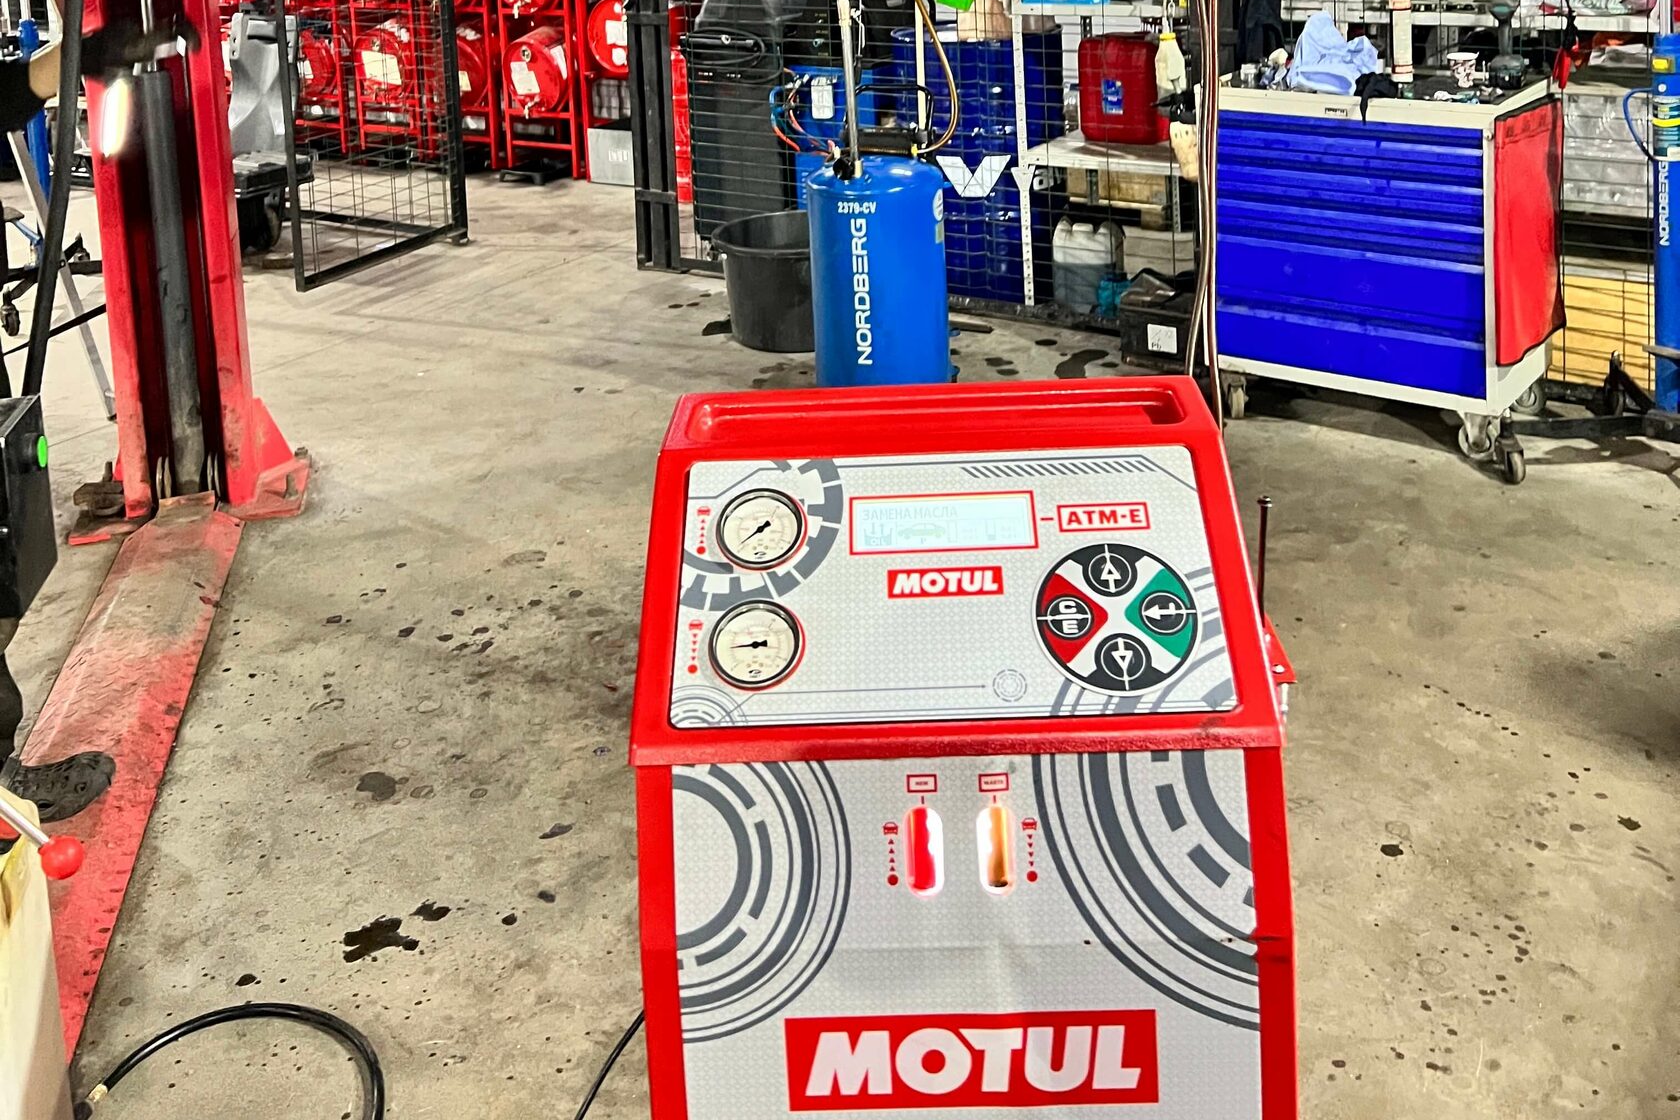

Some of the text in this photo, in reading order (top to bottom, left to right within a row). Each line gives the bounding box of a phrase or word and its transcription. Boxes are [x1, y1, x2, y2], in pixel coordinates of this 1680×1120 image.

[1659, 161, 1670, 246] NORDBERG
[850, 218, 873, 365] NORDBERG
[862, 506, 958, 521] ЗАМЕНА МАСЛА
[1067, 508, 1144, 526] ATM-E
[892, 569, 999, 595] MOTUL
[804, 1025, 1142, 1097] MOTUL
